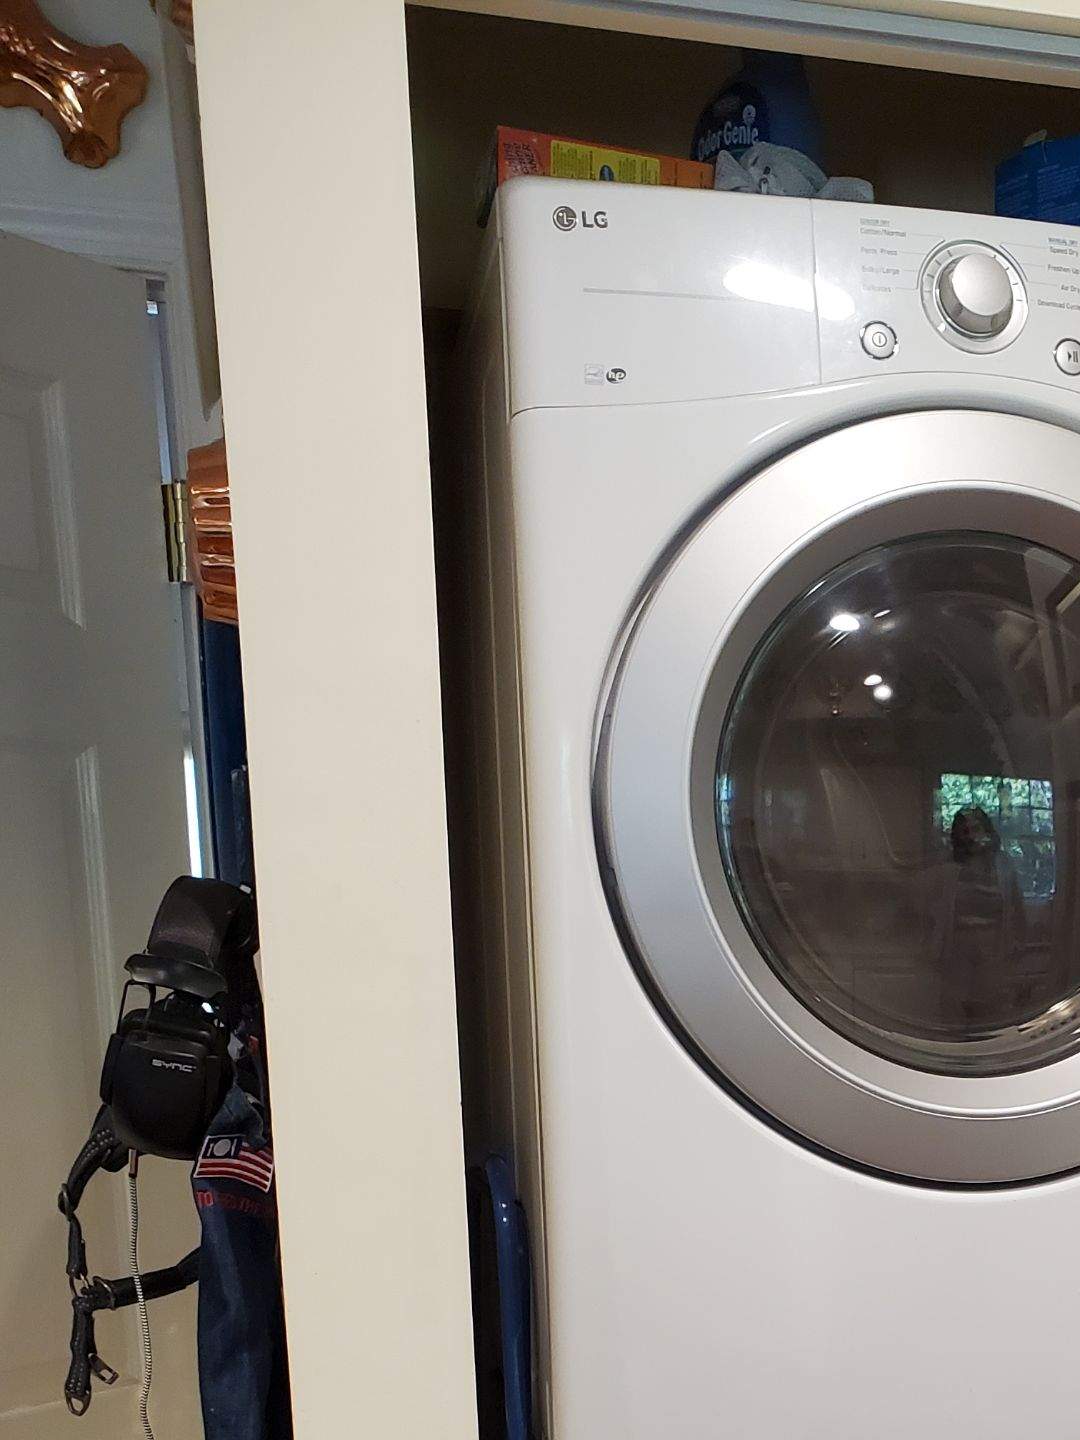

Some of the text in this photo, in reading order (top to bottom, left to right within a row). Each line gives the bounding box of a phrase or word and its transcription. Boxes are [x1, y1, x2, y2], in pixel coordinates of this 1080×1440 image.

[723, 120, 760, 146] Genie
[581, 210, 609, 229] LG
[1068, 248, 1079, 257] Dry
